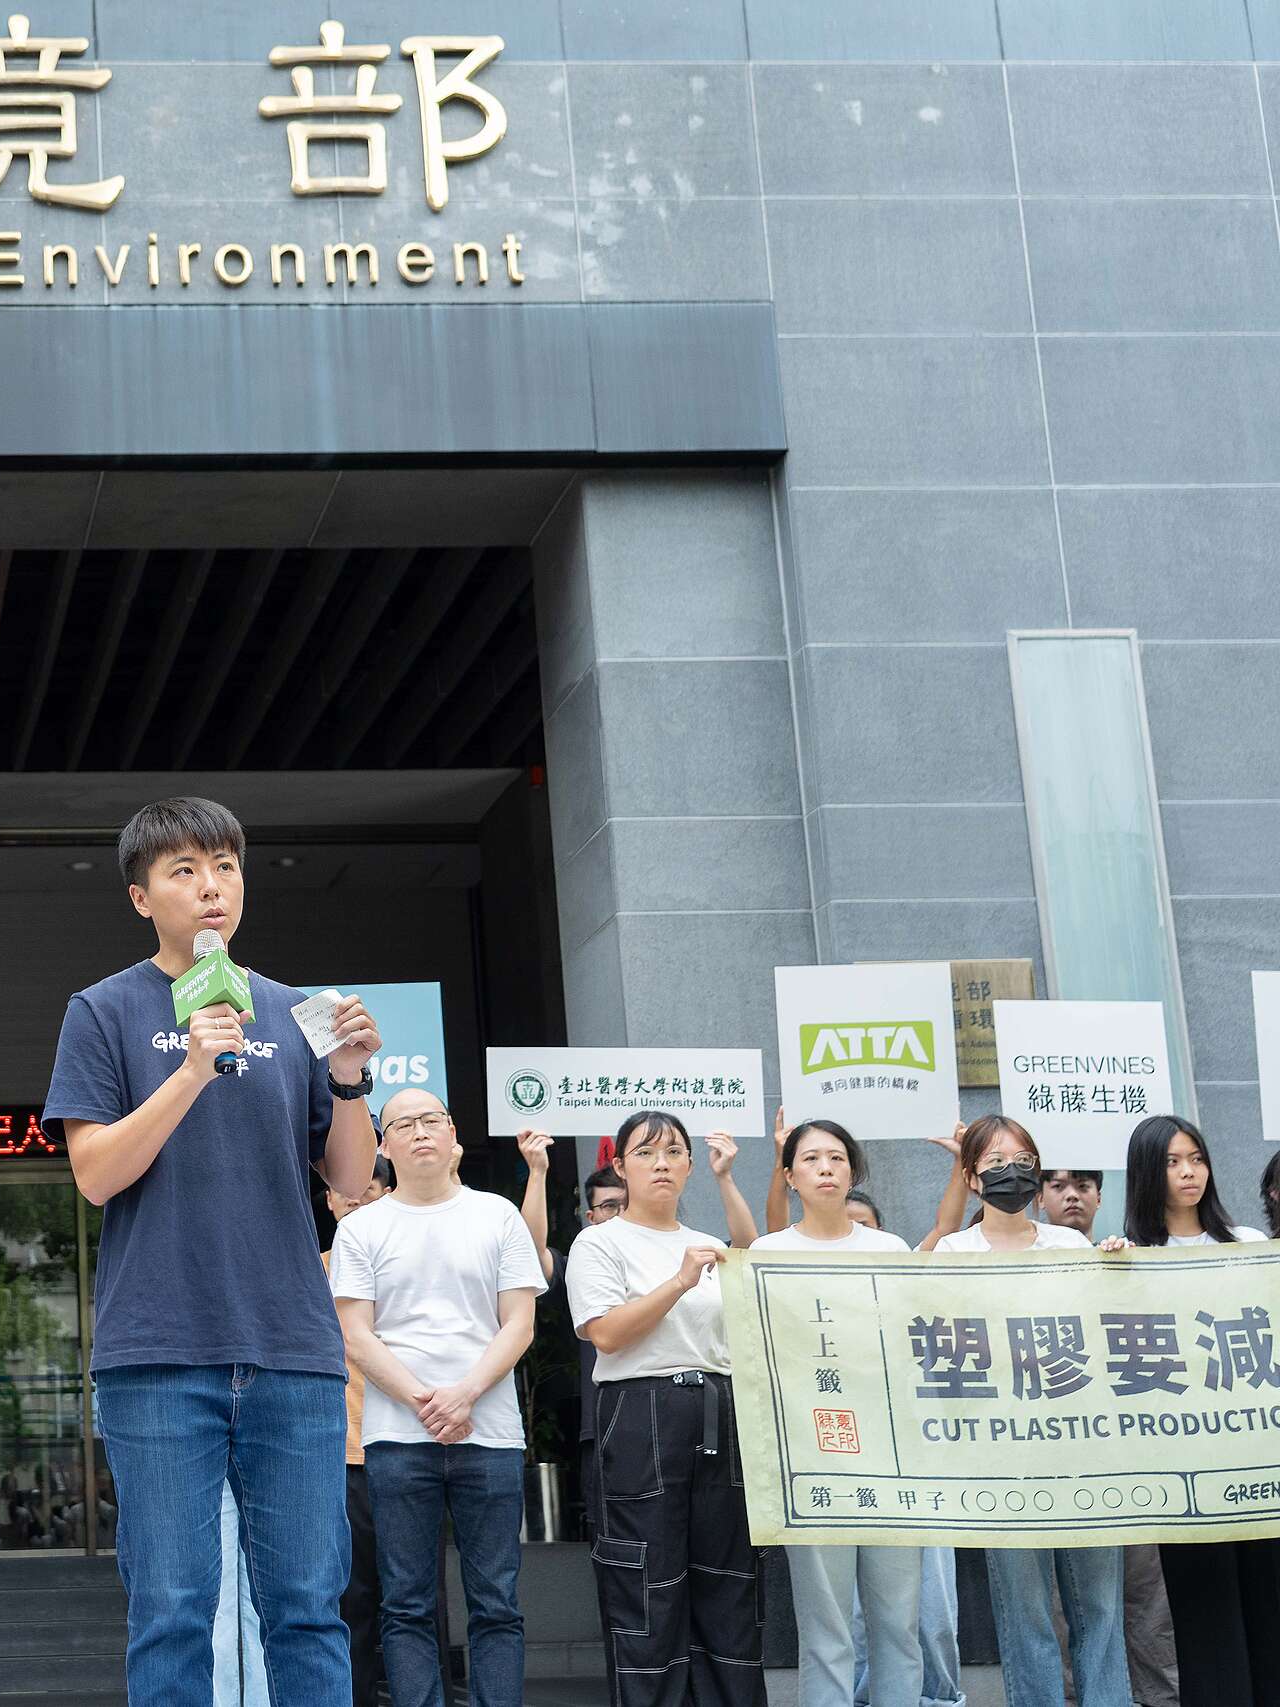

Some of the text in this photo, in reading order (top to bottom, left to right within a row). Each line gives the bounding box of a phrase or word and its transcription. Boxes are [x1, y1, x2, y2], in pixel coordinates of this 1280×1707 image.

[152, 1031, 278, 1058] GREACE
[807, 1026, 929, 1067] ATTA
[1013, 1055, 1155, 1075] GREENVINES
[558, 1076, 746, 1095] 臺北醫學大學附設醫院
[1028, 1084, 1149, 1114] 綠藤生機
[558, 1097, 591, 1108] Taipei
[594, 1097, 637, 1107] Medical
[641, 1097, 696, 1109] University
[700, 1098, 746, 1109] Hospital
[908, 1306, 1280, 1400] 塑膠要減
[922, 1417, 980, 1442] CUT
[989, 1414, 1111, 1441] PLASTIC
